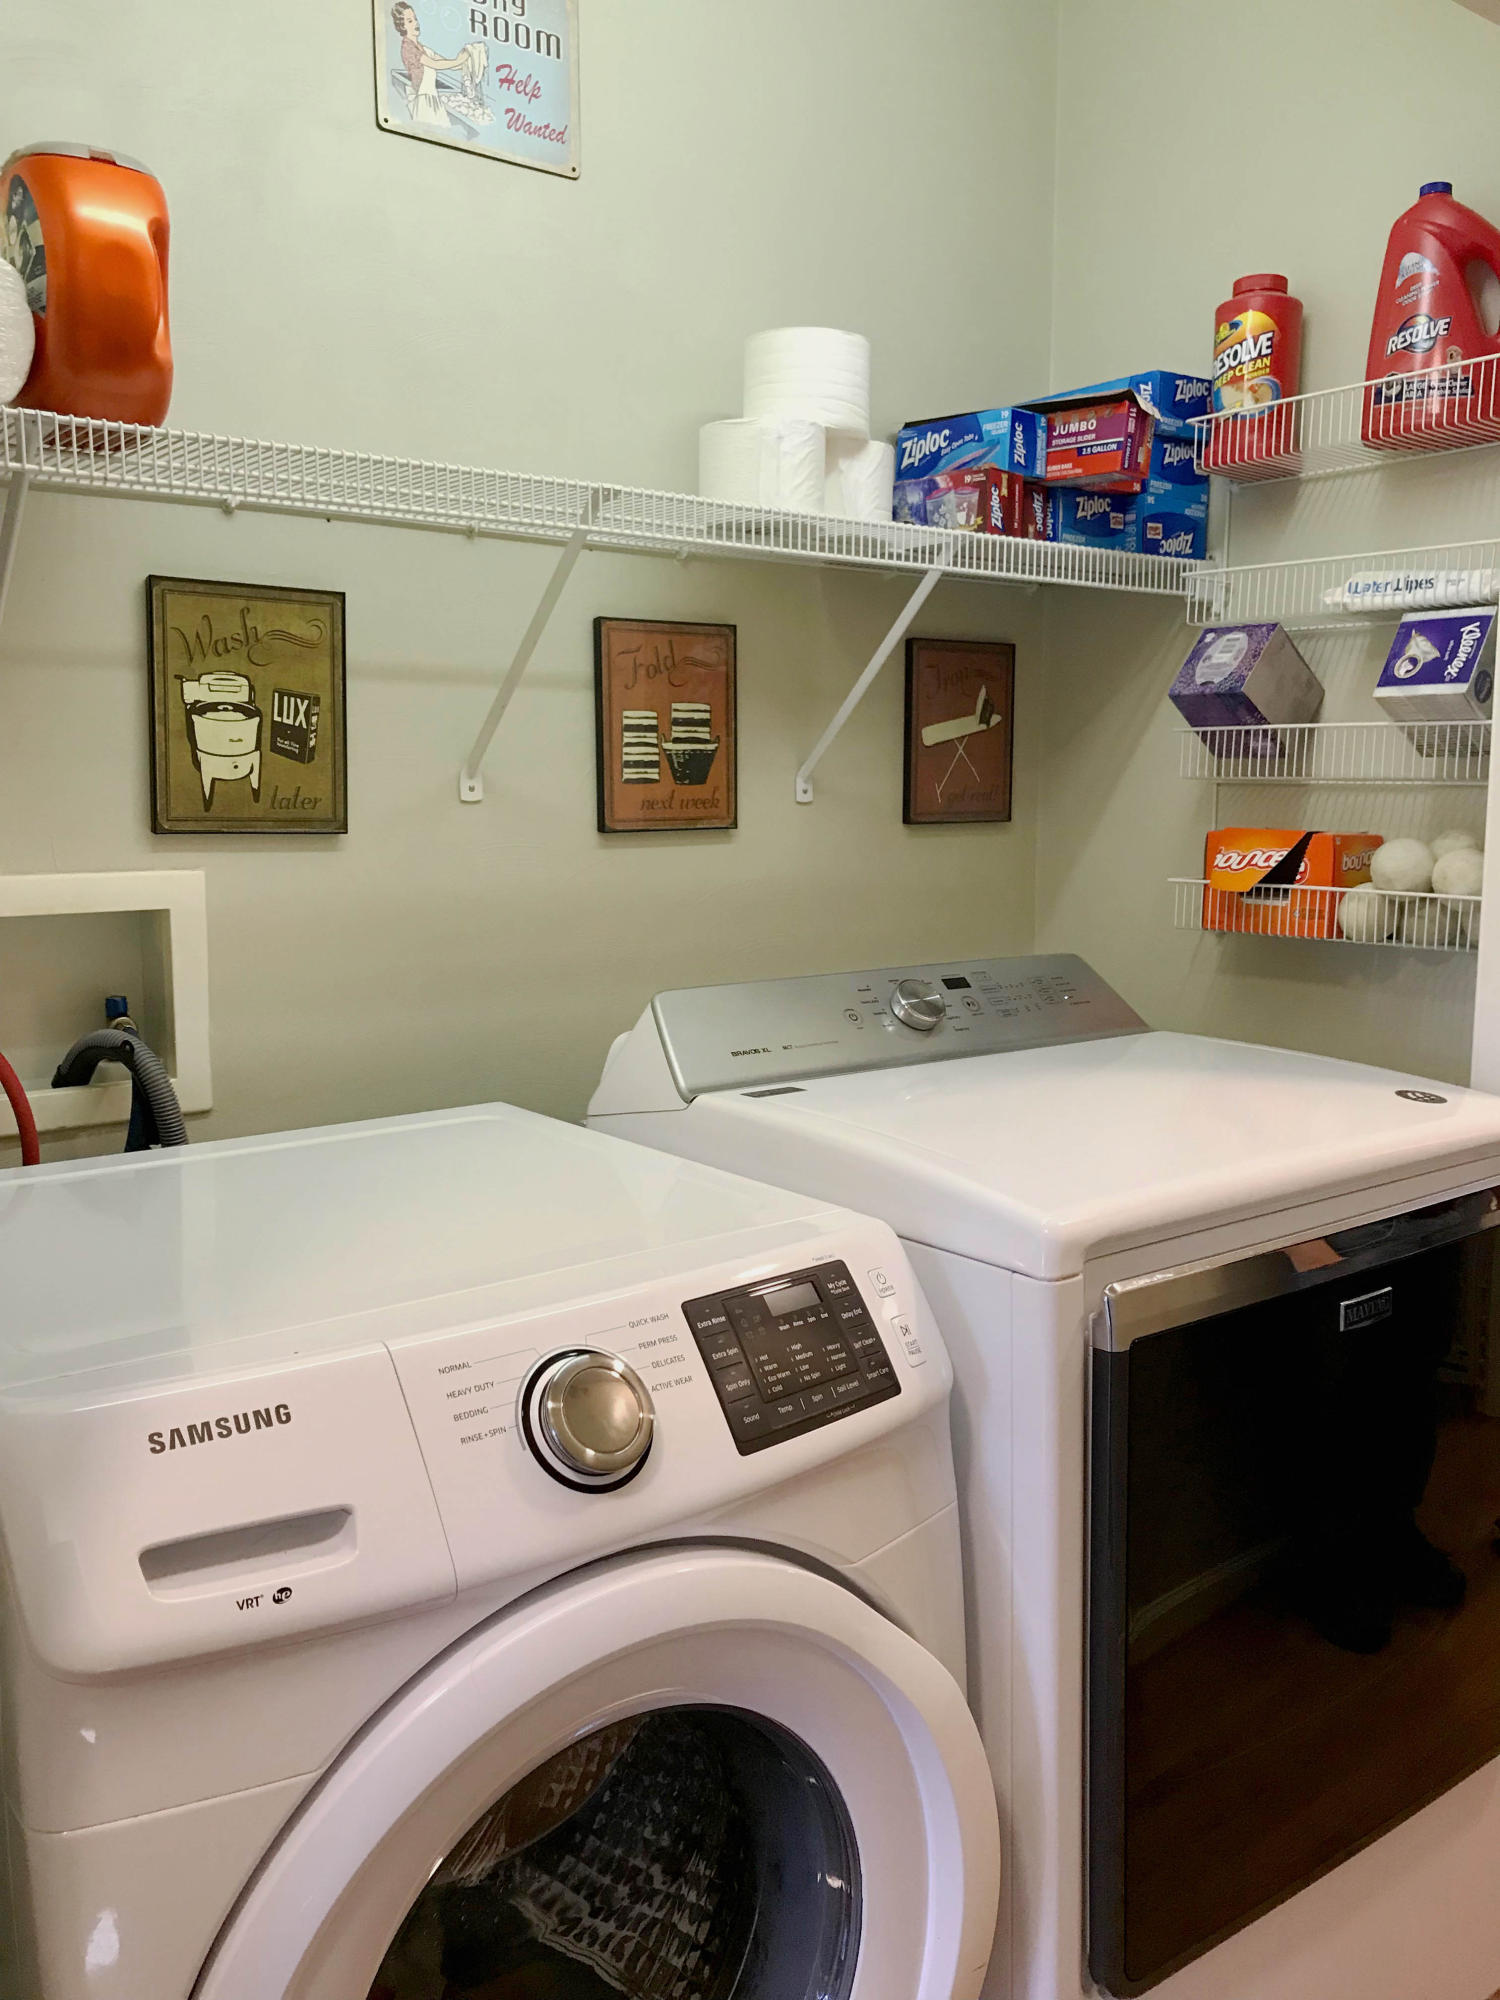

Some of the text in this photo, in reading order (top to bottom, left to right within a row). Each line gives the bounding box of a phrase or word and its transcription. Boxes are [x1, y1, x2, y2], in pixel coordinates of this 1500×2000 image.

[496, 64, 542, 104] Help
[504, 107, 568, 144] Wanted
[1386, 317, 1451, 357] RESOLVE
[1214, 355, 1271, 391] DEEP CLEAN
[1174, 379, 1210, 403] Ziploc
[1052, 419, 1097, 436] JUMBO
[901, 429, 950, 470] Ziploc
[1014, 422, 1026, 467] Ziploc
[1081, 443, 1118, 455] 2.5 GALLON
[990, 486, 1003, 530] Ziploc
[1032, 490, 1044, 532] Ziploc
[1075, 495, 1112, 520] Ziploc
[1159, 531, 1194, 555] Ziploc
[170, 606, 266, 667] Wash
[1444, 621, 1482, 678] Kleenex
[616, 639, 685, 691] Fold
[273, 692, 310, 730] LUX
[269, 785, 323, 812] later
[640, 789, 721, 812] next week
[1342, 850, 1375, 871] bounc
[827, 1282, 836, 1290] My
[628, 1312, 670, 1329] QUICK WASH
[841, 1310, 854, 1319] Delay
[697, 1319, 712, 1329] Extra
[638, 1334, 678, 1350] PERM PRESS
[651, 1354, 686, 1369] DELICATES
[711, 1347, 739, 1360] Extra Spin
[795, 1351, 813, 1360] Medium
[830, 1352, 847, 1361] Normal
[438, 1361, 472, 1375] NORMAL
[763, 1363, 778, 1371] Warm
[776, 1370, 791, 1379] Warm
[810, 1371, 821, 1380] Spin
[866, 1367, 890, 1380] Smart Care
[446, 1381, 495, 1400] HEAVY DUTY
[651, 1375, 693, 1392] ACTIVE WEAR
[725, 1378, 751, 1392] Spin Only
[771, 1384, 783, 1393] Cold
[777, 1380, 860, 1414] Temp Spin Soil Level
[453, 1406, 489, 1422] BEDDING
[743, 1412, 760, 1423] Sound
[148, 1404, 292, 1454] SAMSUNG
